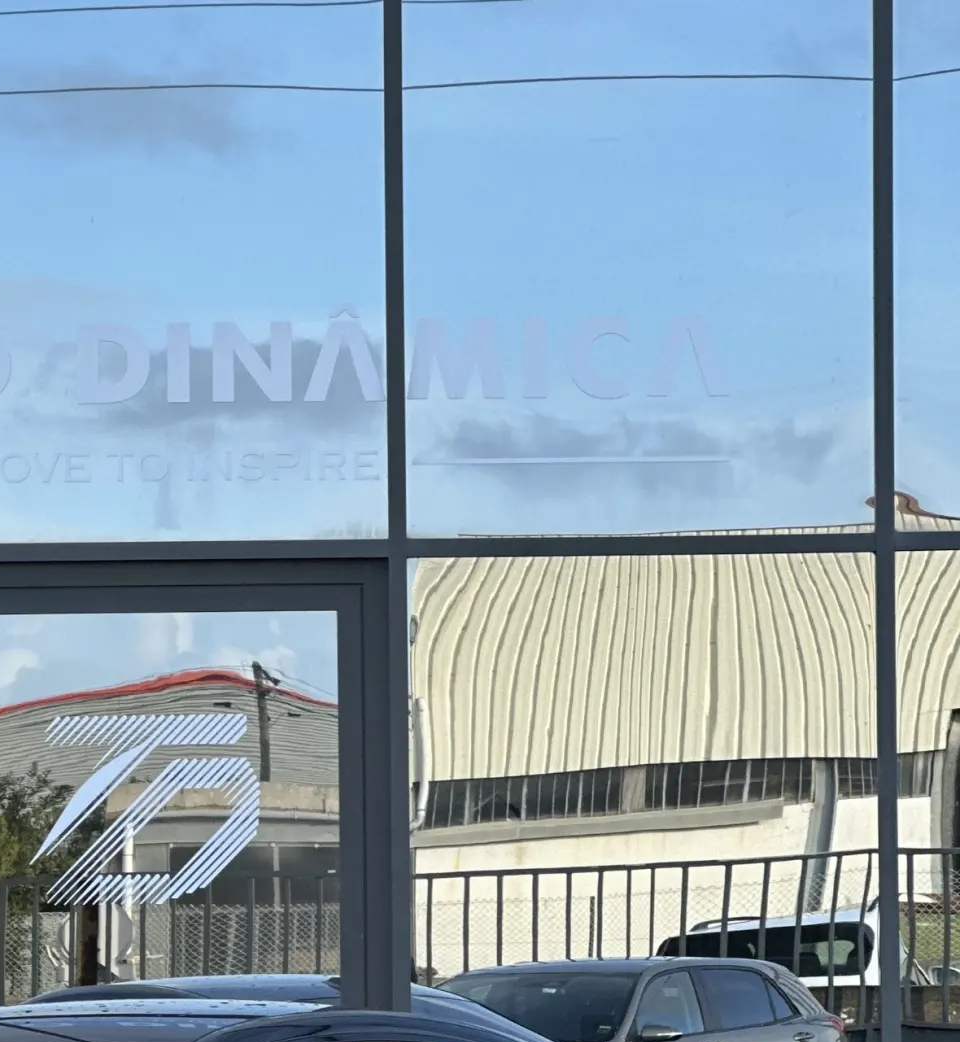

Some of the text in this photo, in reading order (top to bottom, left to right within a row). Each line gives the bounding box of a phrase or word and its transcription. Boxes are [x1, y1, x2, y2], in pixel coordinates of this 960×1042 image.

[77, 302, 730, 406] DINÂMICA
[106, 451, 171, 483] TO
[187, 449, 381, 482] INSPIRE
